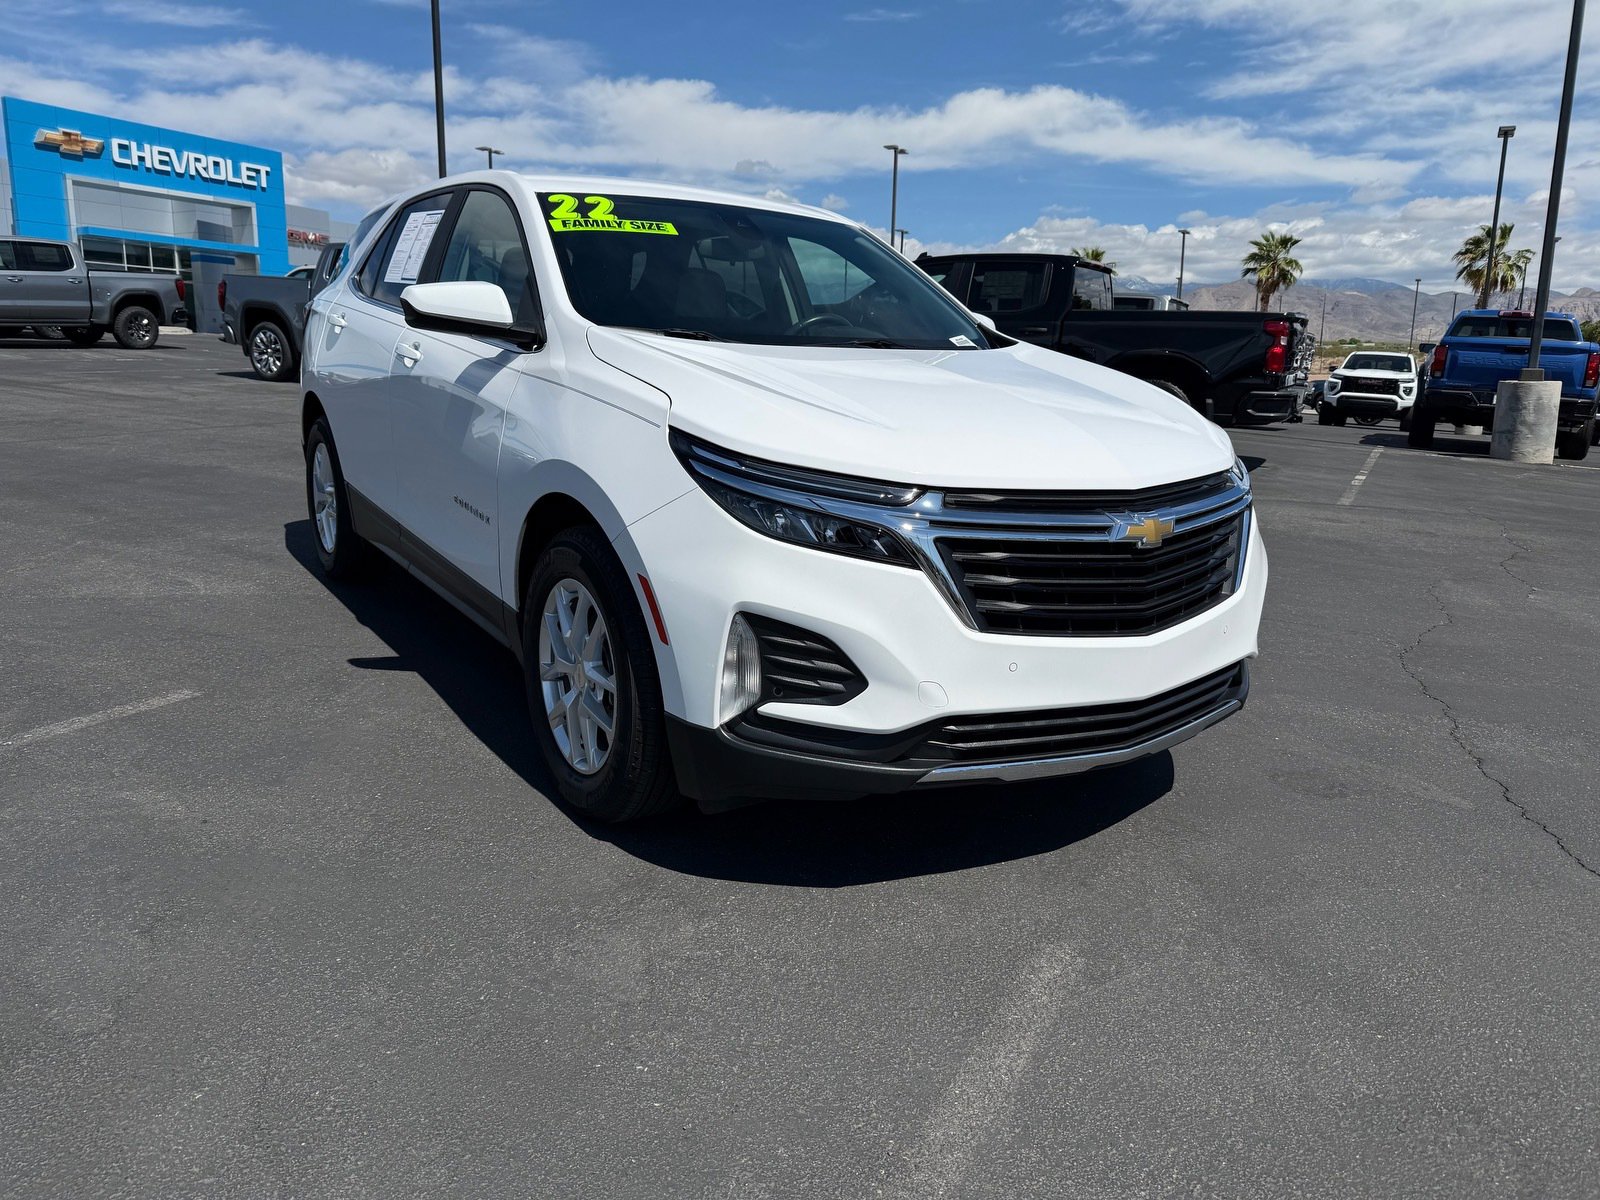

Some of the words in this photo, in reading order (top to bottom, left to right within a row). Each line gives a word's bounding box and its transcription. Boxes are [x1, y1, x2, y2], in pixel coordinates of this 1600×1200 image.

[111, 138, 271, 189] CHEVROLET
[547, 194, 618, 220] 22
[561, 219, 625, 229] FAMILY
[629, 221, 669, 231] SIZE
[287, 228, 329, 246] GMC
